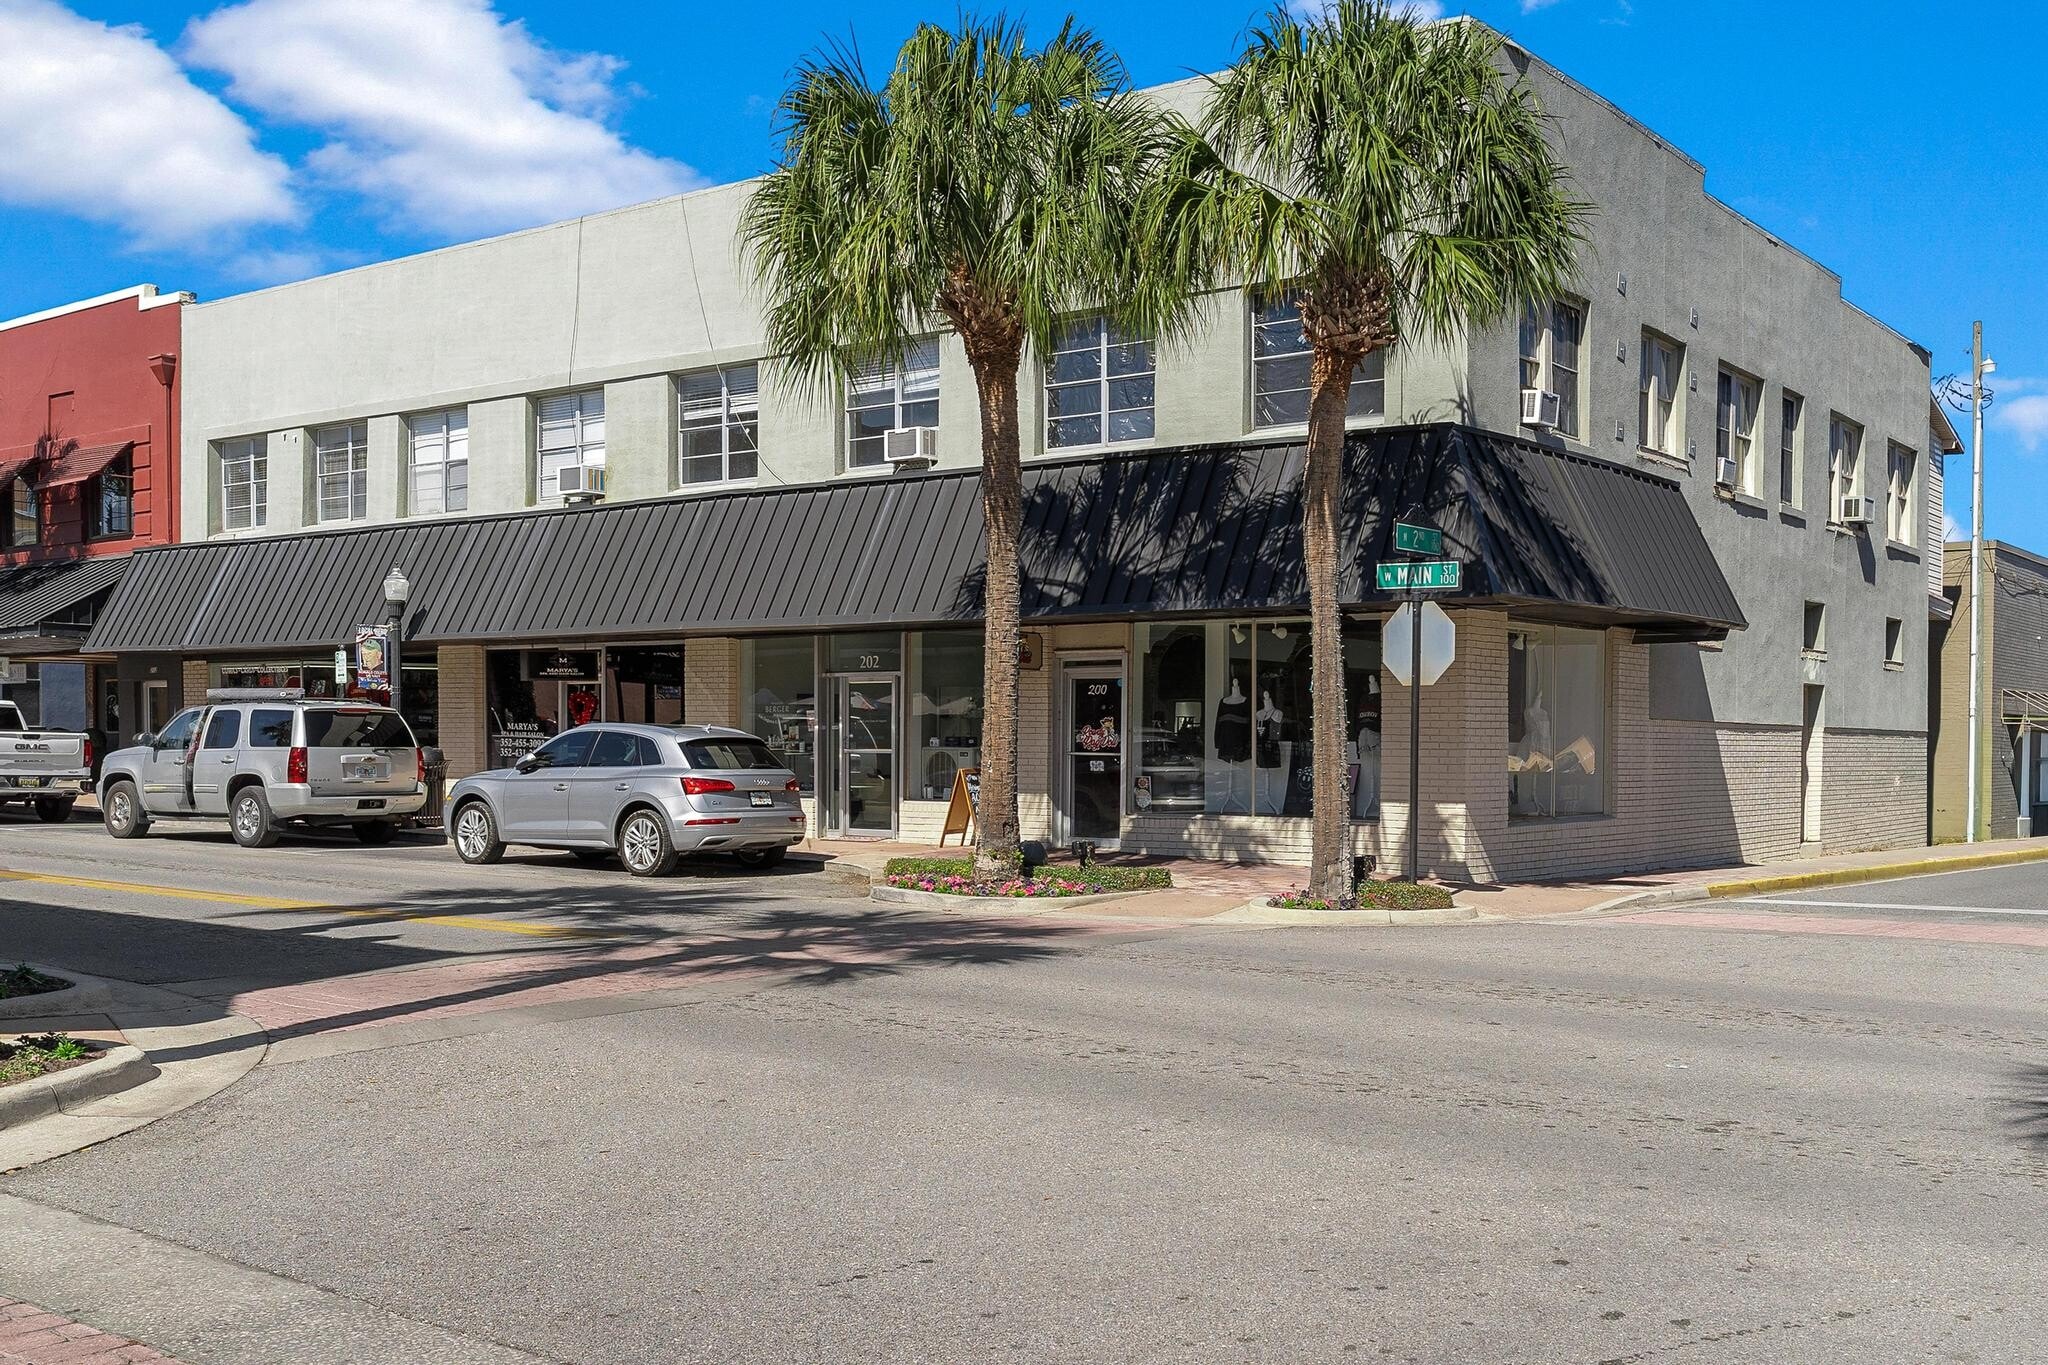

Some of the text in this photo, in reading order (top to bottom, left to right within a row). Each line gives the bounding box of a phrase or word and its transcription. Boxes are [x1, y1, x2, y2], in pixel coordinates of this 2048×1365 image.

[1384, 564, 1453, 585] W MAIN ST
[1440, 574, 1456, 584] 100
[859, 655, 880, 669] 202
[1087, 684, 1108, 696] 200
[507, 722, 539, 731] MARYA'S
[14, 743, 49, 751] GMC
